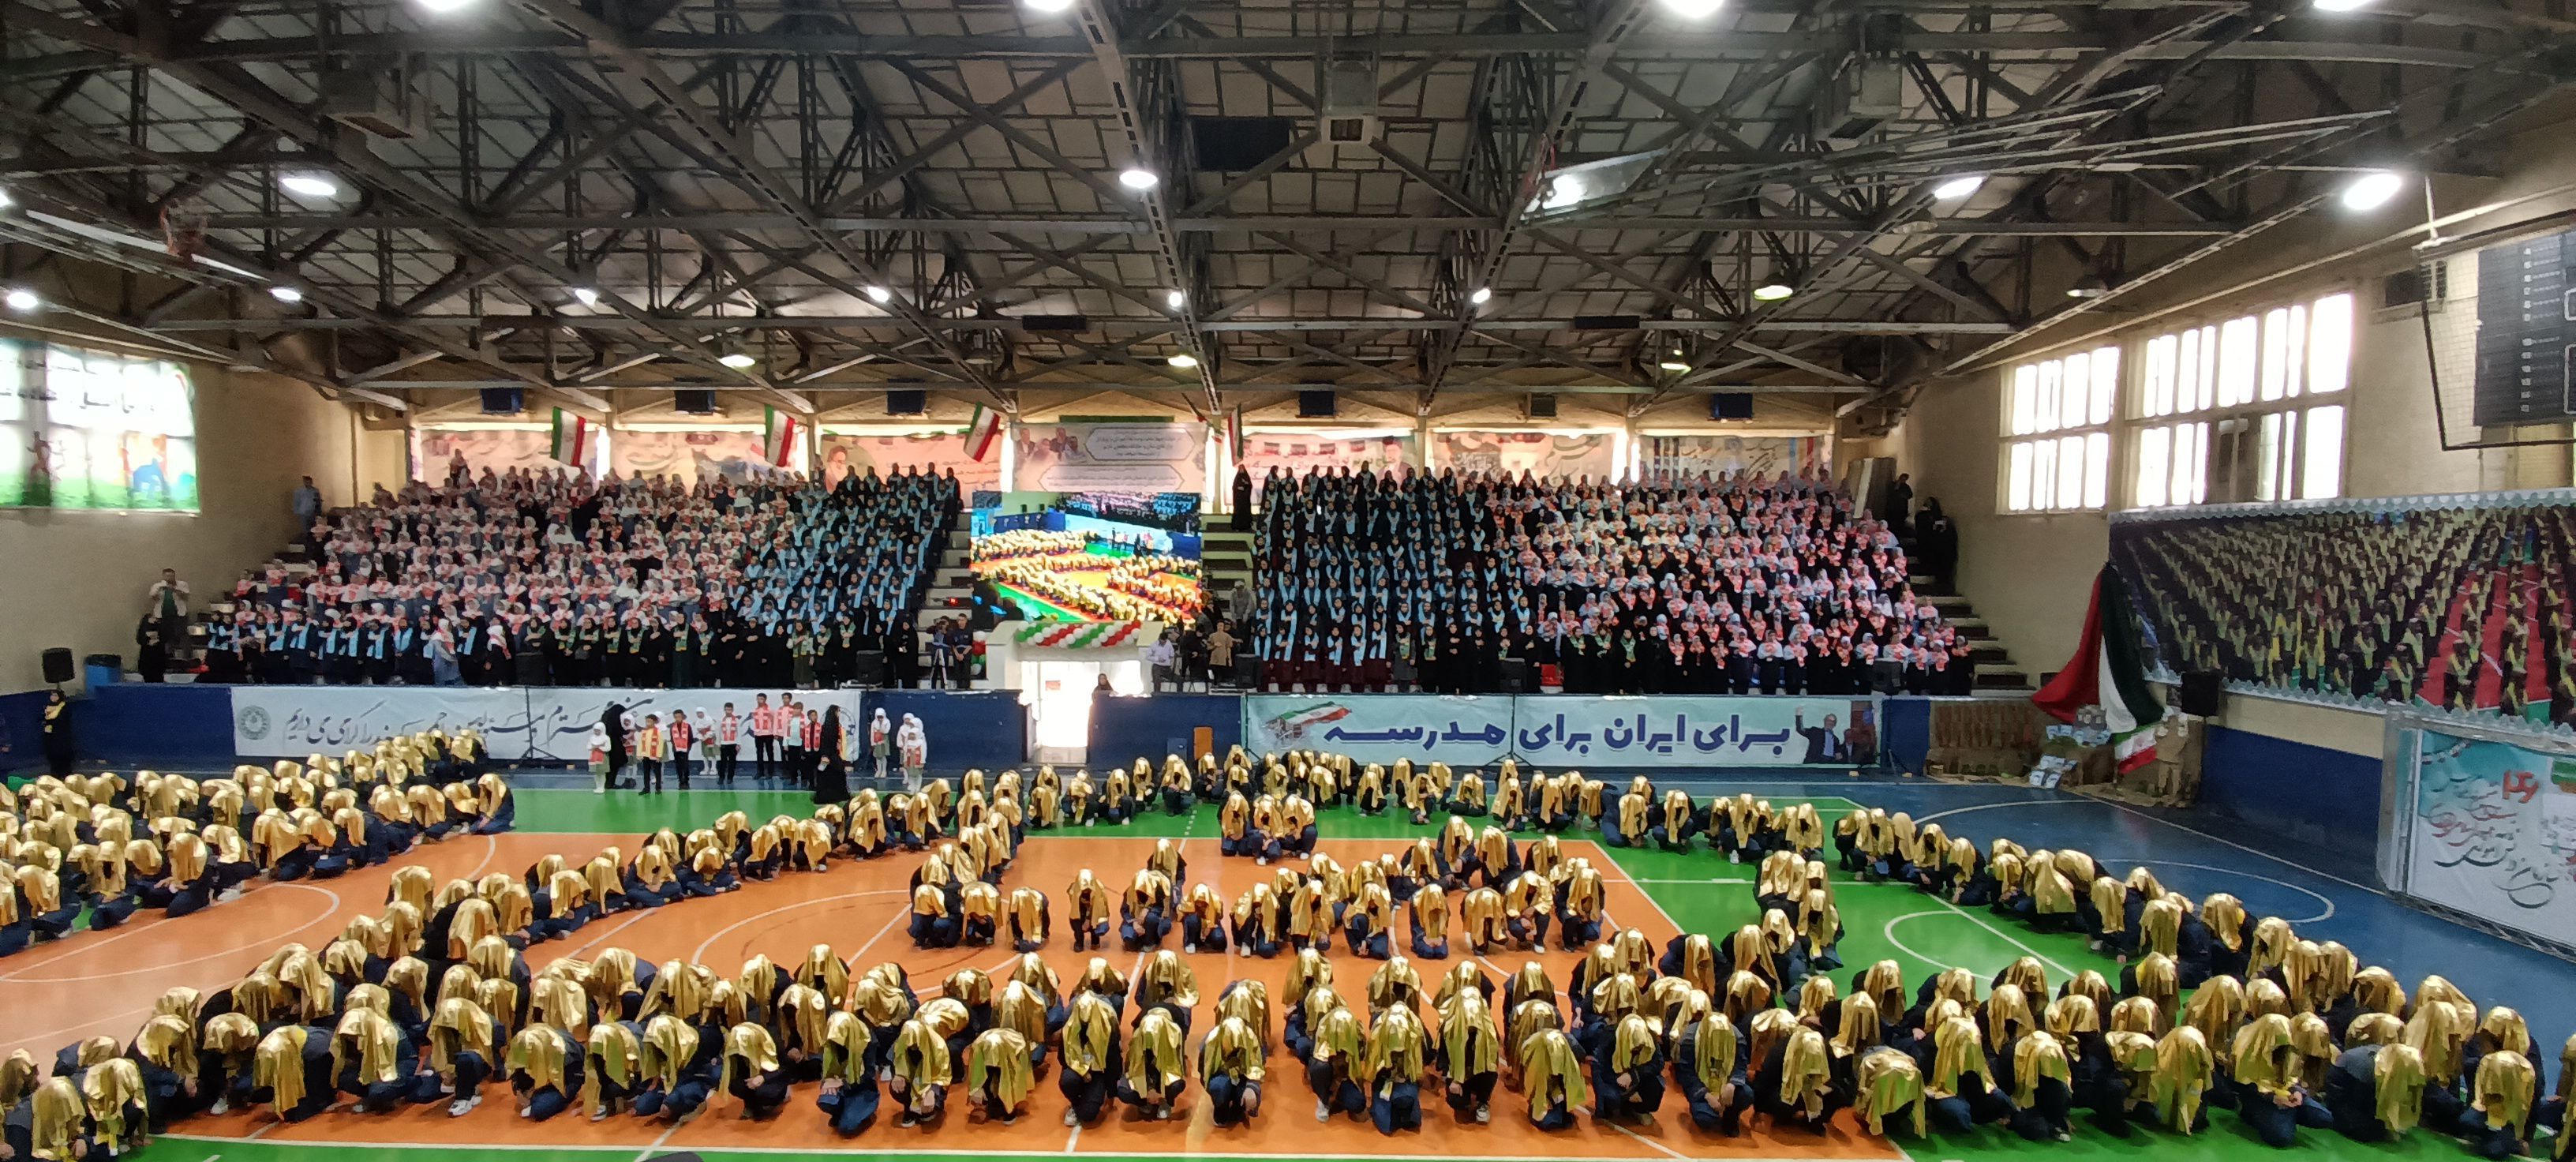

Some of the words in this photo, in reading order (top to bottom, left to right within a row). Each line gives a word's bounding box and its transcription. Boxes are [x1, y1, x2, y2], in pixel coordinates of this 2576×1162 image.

[1324, 721, 1507, 751] مدرسه
[1519, 714, 1592, 755] برای
[1604, 714, 1686, 752] ایران
[1694, 714, 1790, 755] برای
